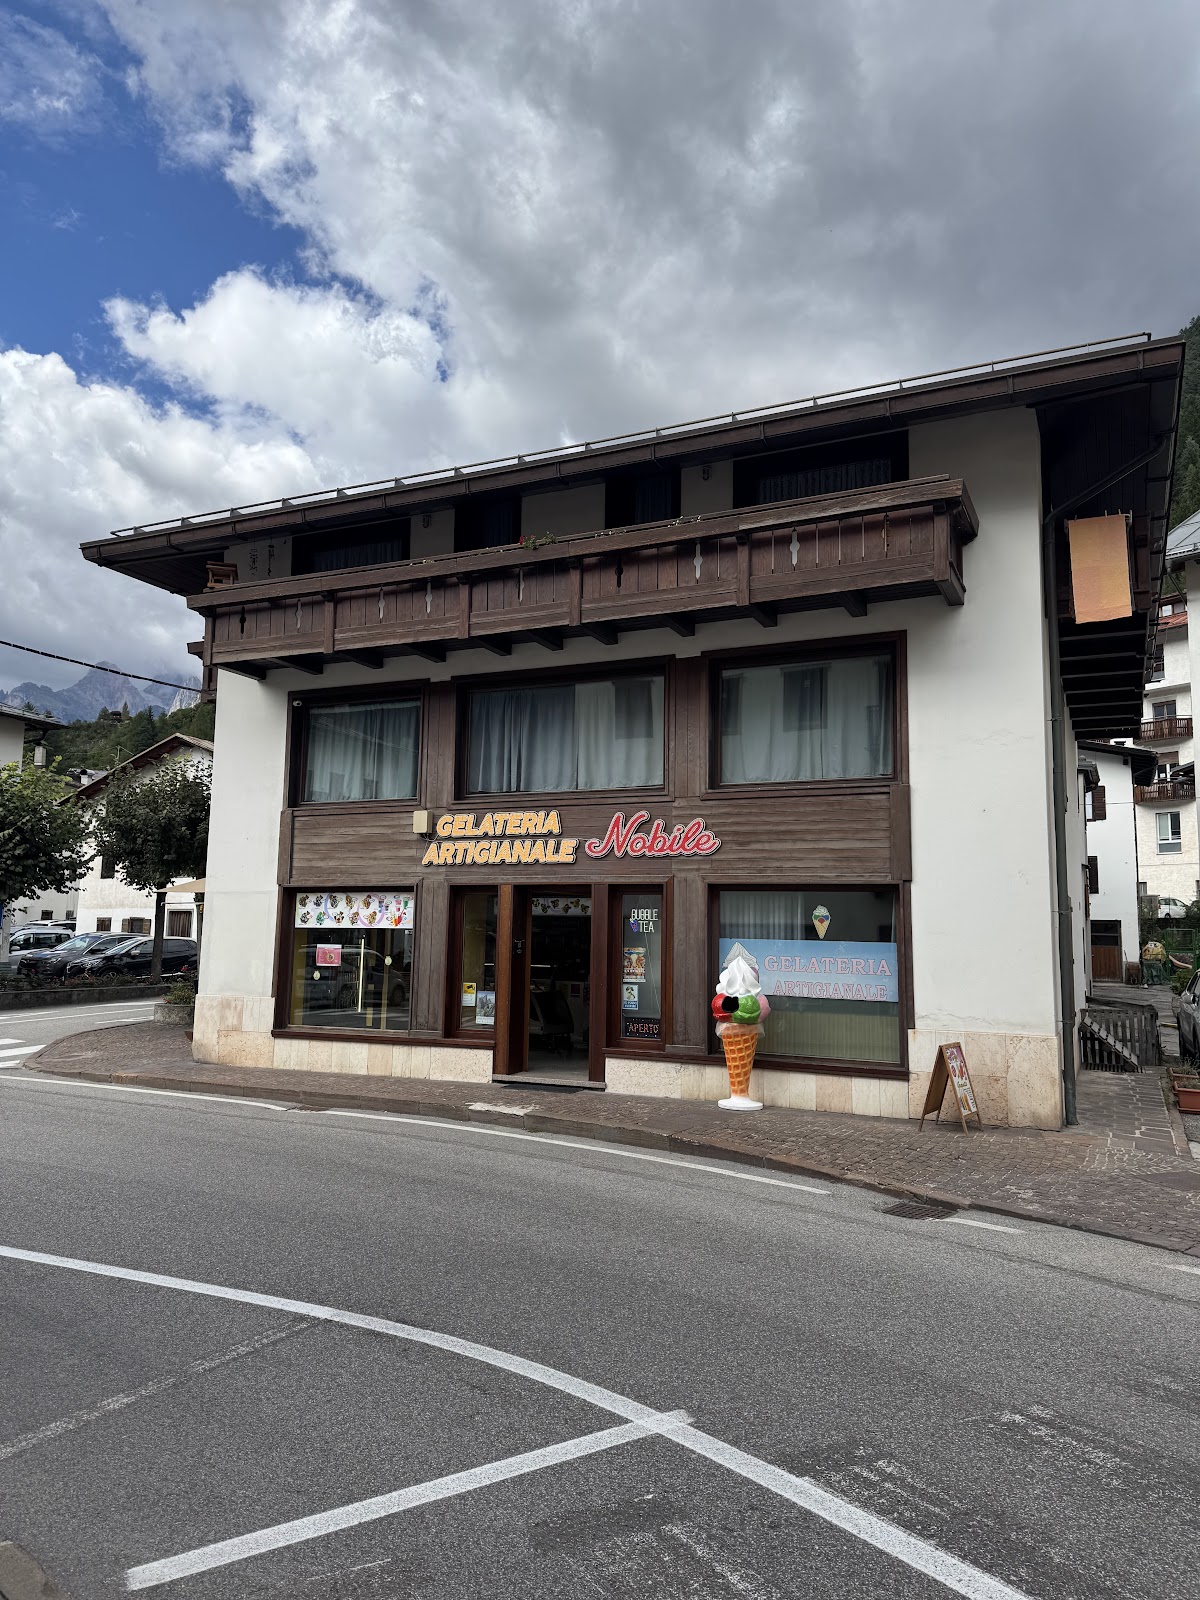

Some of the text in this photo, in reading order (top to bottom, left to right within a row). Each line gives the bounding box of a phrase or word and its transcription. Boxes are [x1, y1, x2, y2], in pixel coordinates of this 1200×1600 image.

[435, 809, 562, 837] GELATERIA
[585, 810, 722, 858] Nobile
[421, 838, 580, 866] ARTIGIANALE
[631, 908, 659, 921] BUBBLE
[638, 920, 655, 933] TEA
[763, 954, 892, 976] GELATERIA
[772, 980, 888, 1001] ARTIGIANALE
[628, 1022, 660, 1034] APERTO
